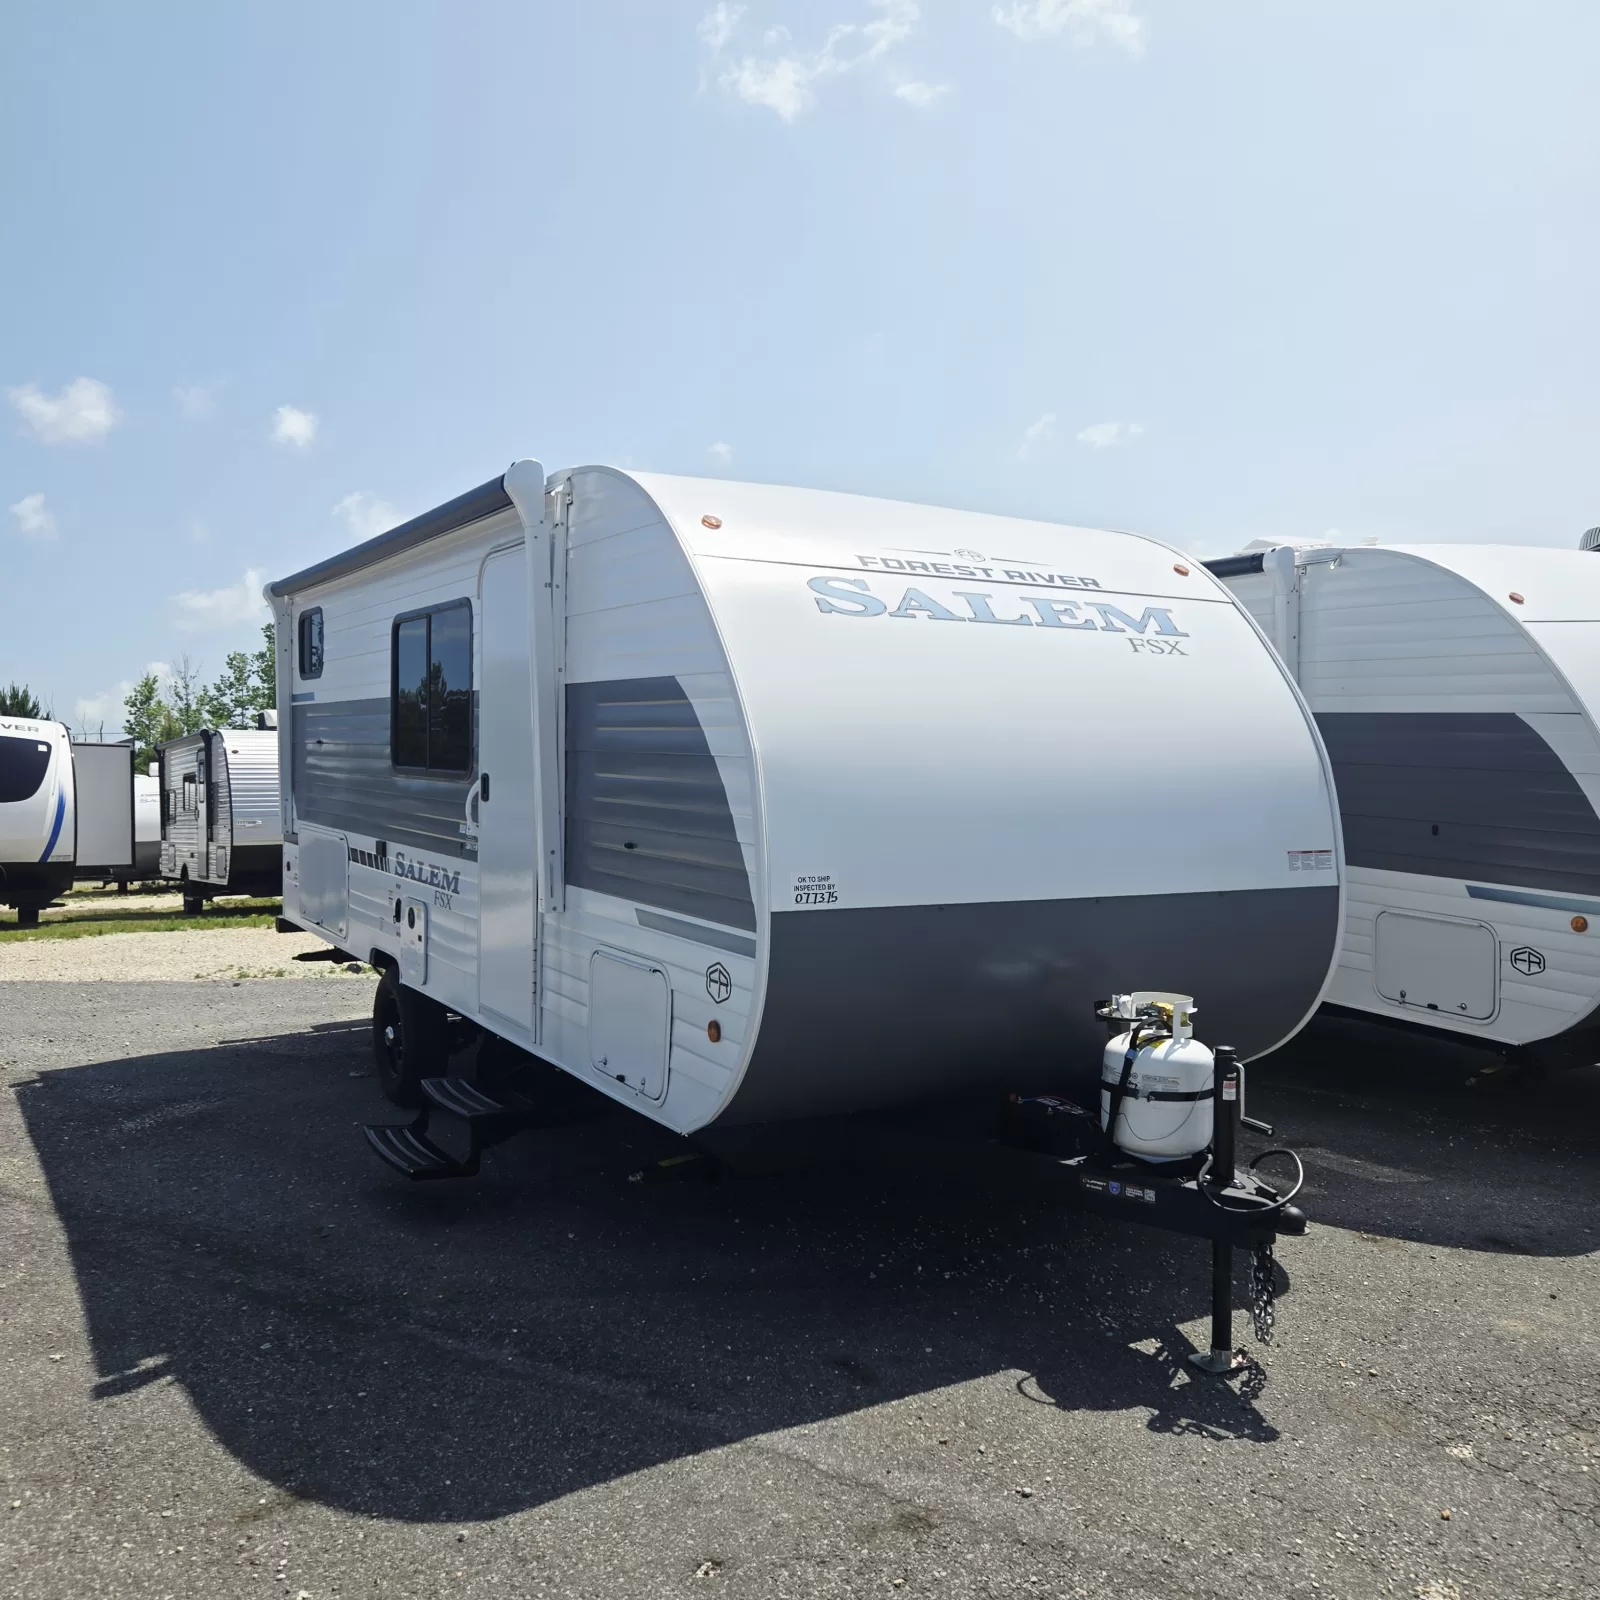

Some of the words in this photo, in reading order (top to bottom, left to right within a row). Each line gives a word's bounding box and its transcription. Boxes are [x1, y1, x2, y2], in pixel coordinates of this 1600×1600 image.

[853, 555, 993, 578] FOREST
[1001, 569, 1103, 588] RIVER
[806, 575, 1190, 637] SALEM
[1126, 637, 1190, 656] FSX
[395, 852, 461, 895] SALEM
[817, 875, 831, 883] SHIP
[793, 883, 827, 892] INSPECTED
[827, 883, 836, 891] BY
[795, 890, 838, 904] 077375
[434, 890, 453, 911] FSX
